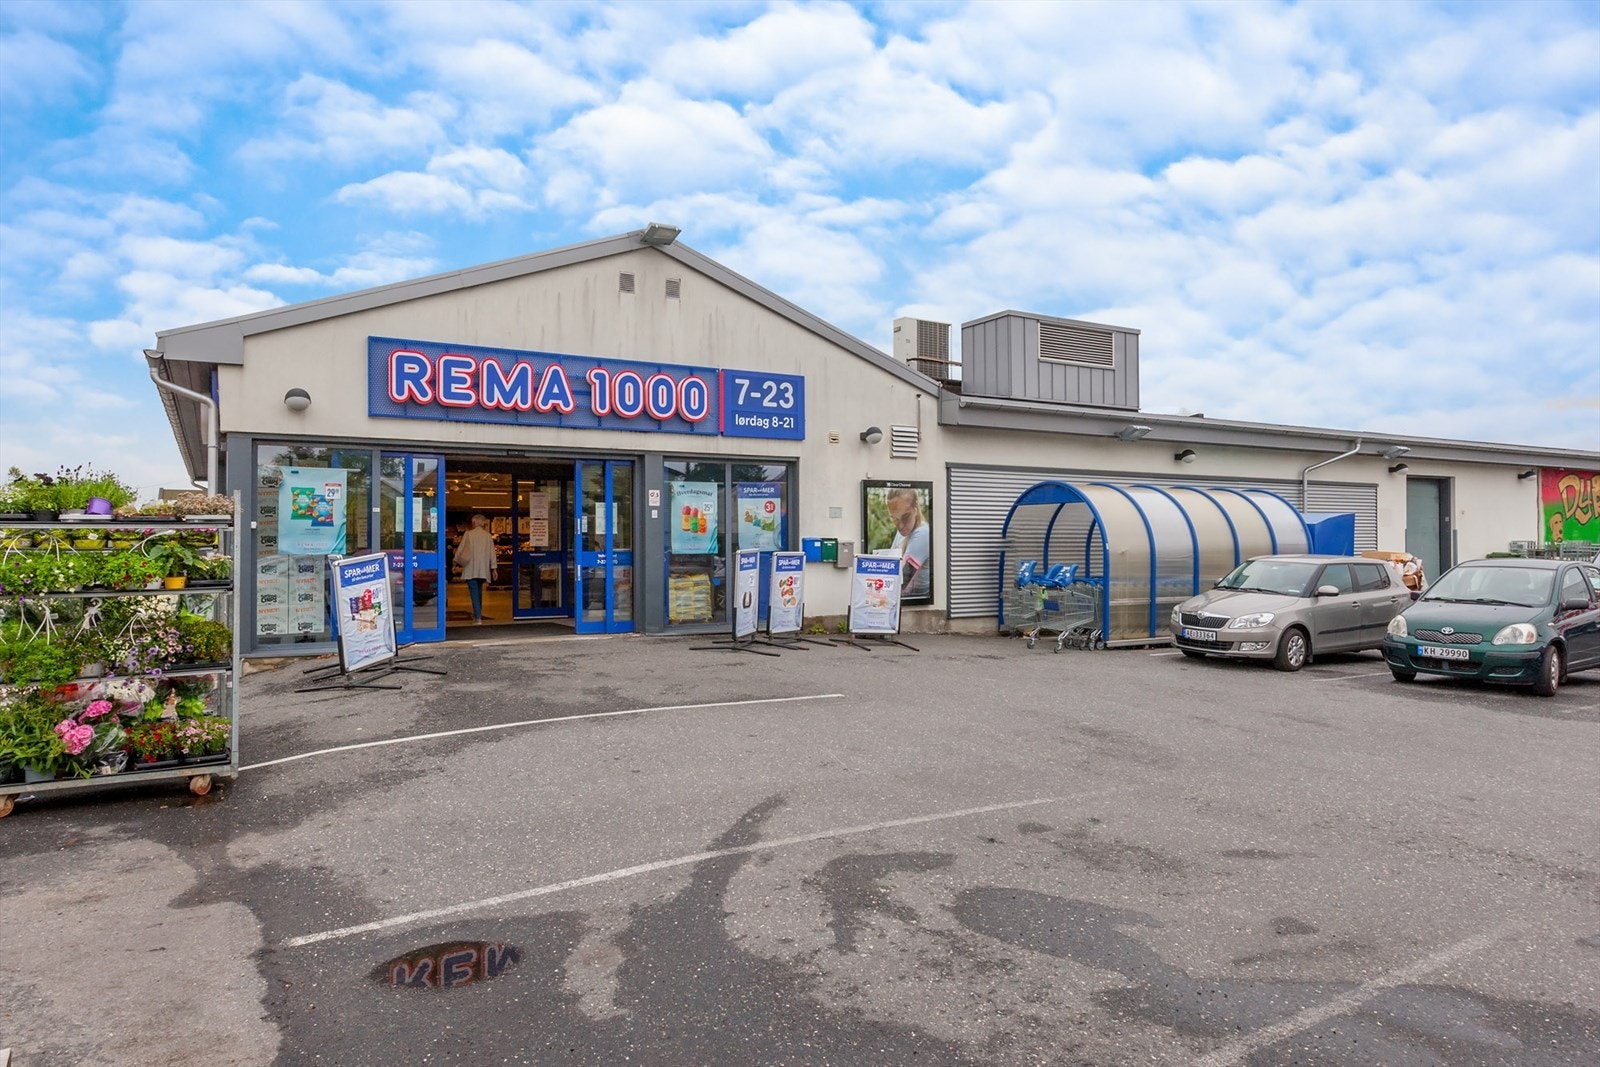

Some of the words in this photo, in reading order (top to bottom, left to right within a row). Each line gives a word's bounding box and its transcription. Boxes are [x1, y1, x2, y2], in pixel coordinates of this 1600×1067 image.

[388, 349, 576, 415] REMA
[586, 367, 709, 423] 1000
[735, 378, 794, 409] 7-23
[735, 414, 769, 429] lørdag
[771, 416, 794, 428] 8-21
[861, 561, 877, 569] SPAR
[344, 567, 361, 579] SPAR
[1424, 647, 1436, 655] KH
[1439, 648, 1468, 658] 29990
